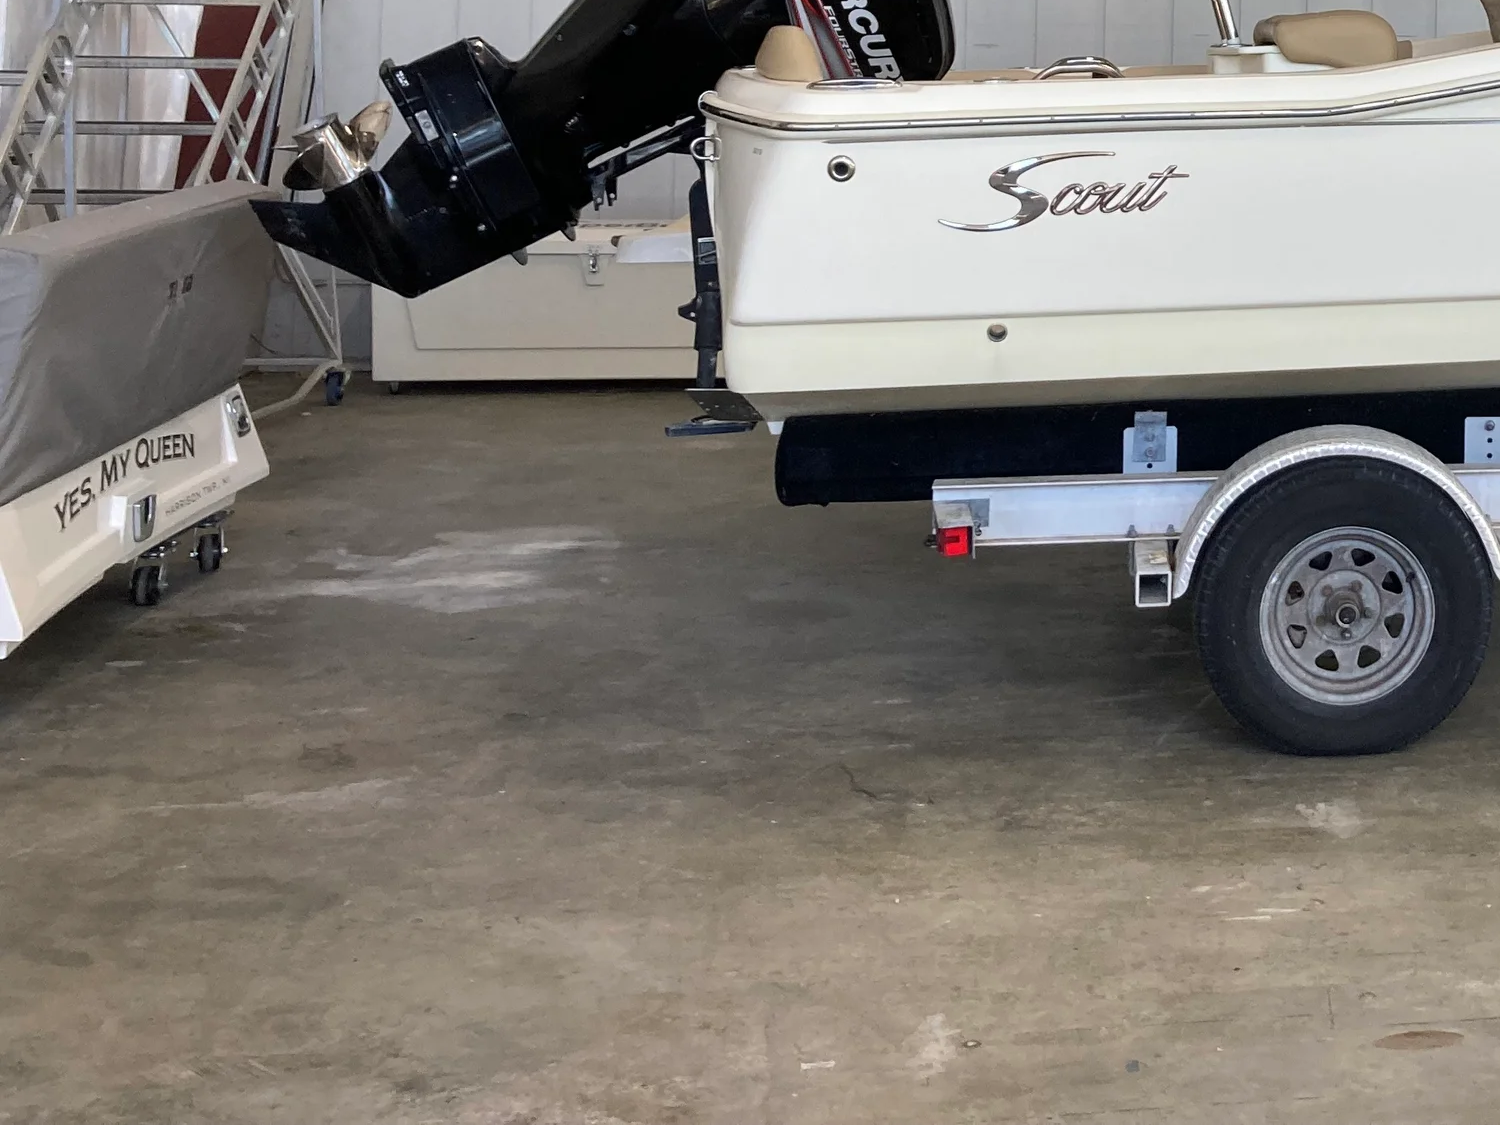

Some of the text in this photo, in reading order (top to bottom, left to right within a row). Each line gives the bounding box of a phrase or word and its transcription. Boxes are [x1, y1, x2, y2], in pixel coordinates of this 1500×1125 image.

[937, 150, 1190, 233] Scout
[54, 433, 196, 533] YES, MY QUEEN
